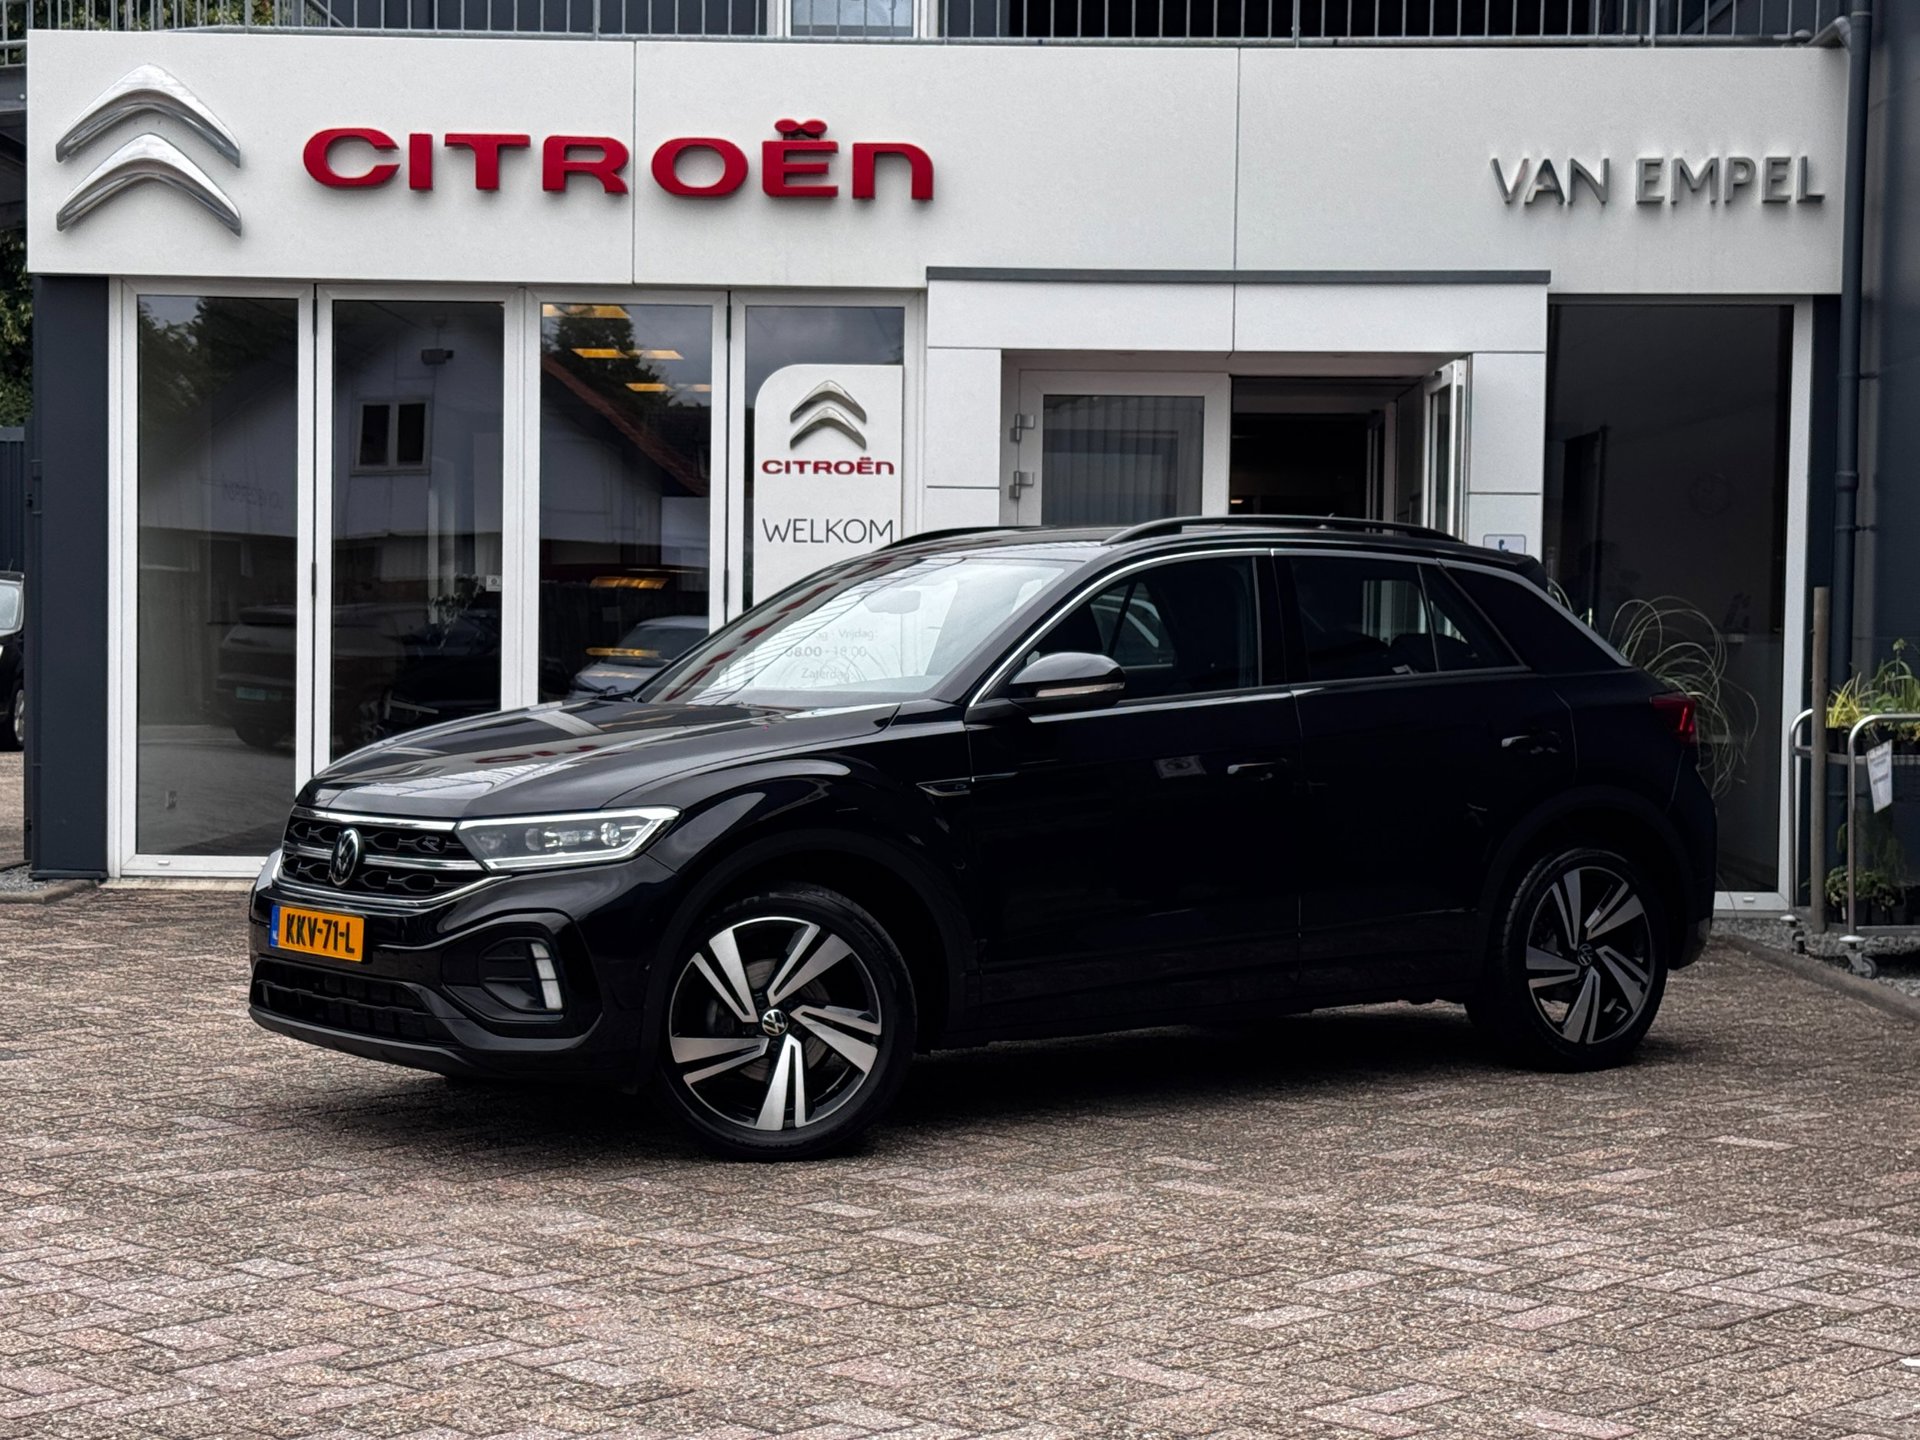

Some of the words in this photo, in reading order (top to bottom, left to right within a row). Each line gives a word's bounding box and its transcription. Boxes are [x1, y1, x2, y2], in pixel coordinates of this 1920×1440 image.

[303, 119, 934, 201] CITROËN
[1490, 157, 1609, 205] VAN
[1635, 156, 1825, 205] EMPEL
[762, 457, 894, 475] CITROËN
[762, 518, 893, 544] WELKOM
[286, 913, 355, 954] KKV-71-L
